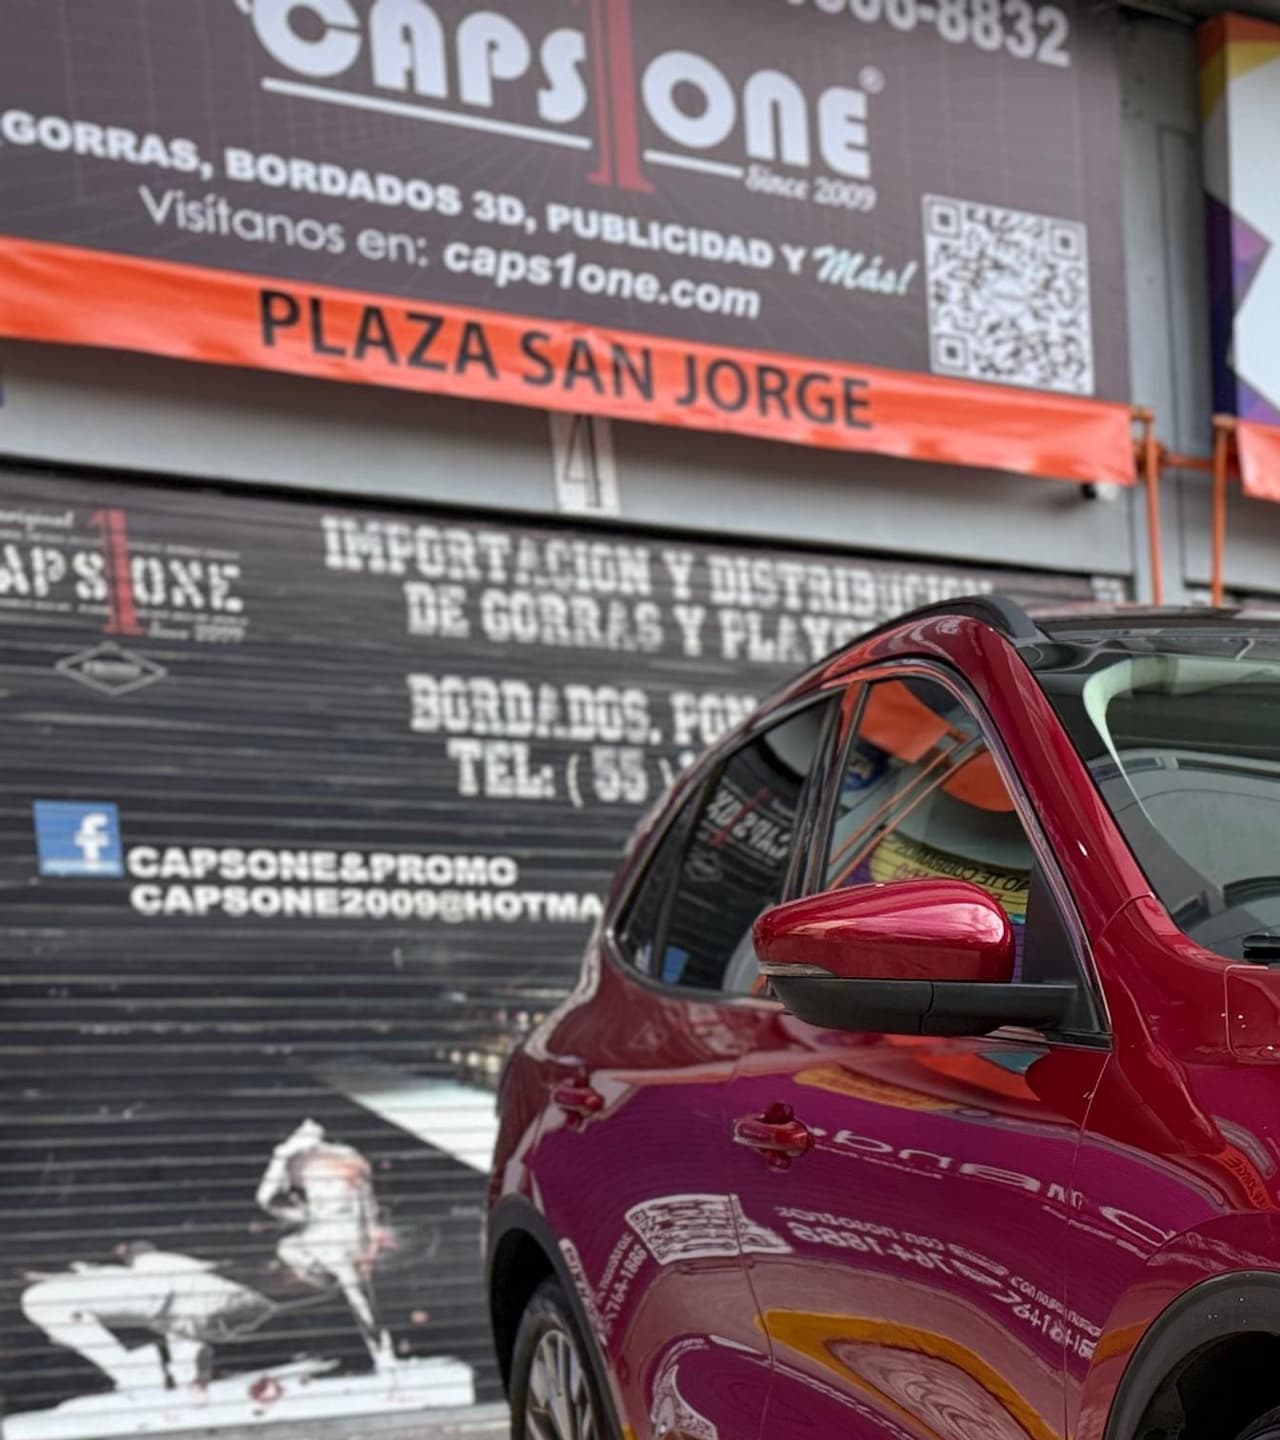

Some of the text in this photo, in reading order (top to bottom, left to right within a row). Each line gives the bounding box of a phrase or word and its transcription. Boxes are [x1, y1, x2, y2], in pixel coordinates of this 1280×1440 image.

[1, 110, 917, 296] GORRAS, BORDADOS 3D, PUBLICIDAD Y Más!
[745, 164, 878, 213] Since 2009
[138, 184, 760, 318] Visítanos en: caps1one.com
[258, 288, 873, 430] PLAZA SAN JORGE
[321, 515, 651, 596] IMPORTACION
[661, 550, 694, 598] Y
[404, 580, 470, 638] DE
[481, 587, 664, 653] GORRAS
[673, 605, 706, 657] Y
[447, 737, 556, 798] TEL:
[127, 847, 518, 886] CAPSONE&PROMO
